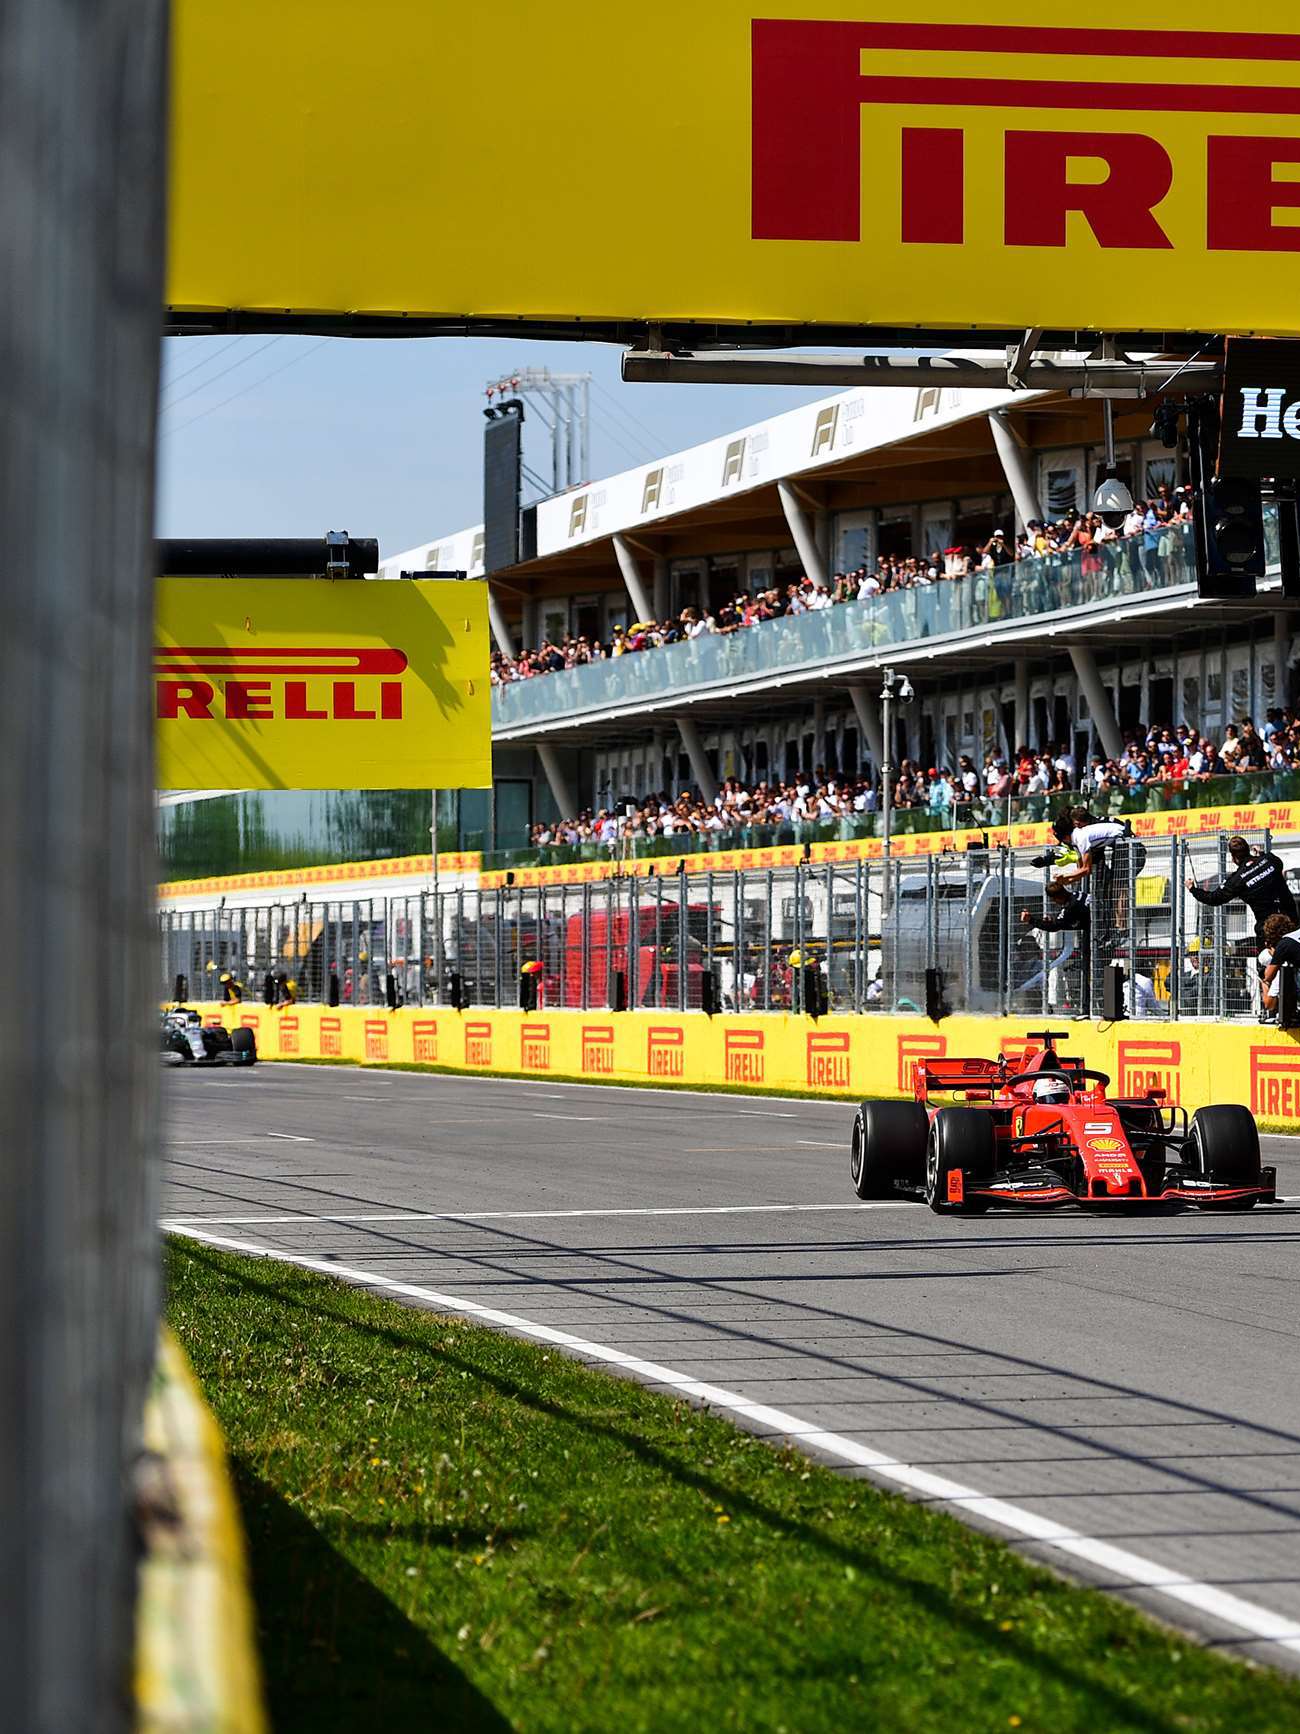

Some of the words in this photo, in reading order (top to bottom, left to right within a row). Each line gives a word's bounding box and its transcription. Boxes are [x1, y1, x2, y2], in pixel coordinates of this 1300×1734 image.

[154, 647, 407, 720] RELLI
[521, 1024, 550, 1070] PIRELLI
[582, 1026, 614, 1074] PIRELLI
[648, 1026, 684, 1077] PIRELLI
[725, 1030, 765, 1083] PIRELLI
[807, 1032, 850, 1088] PIRELLI
[1084, 1122, 1113, 1135] 5
